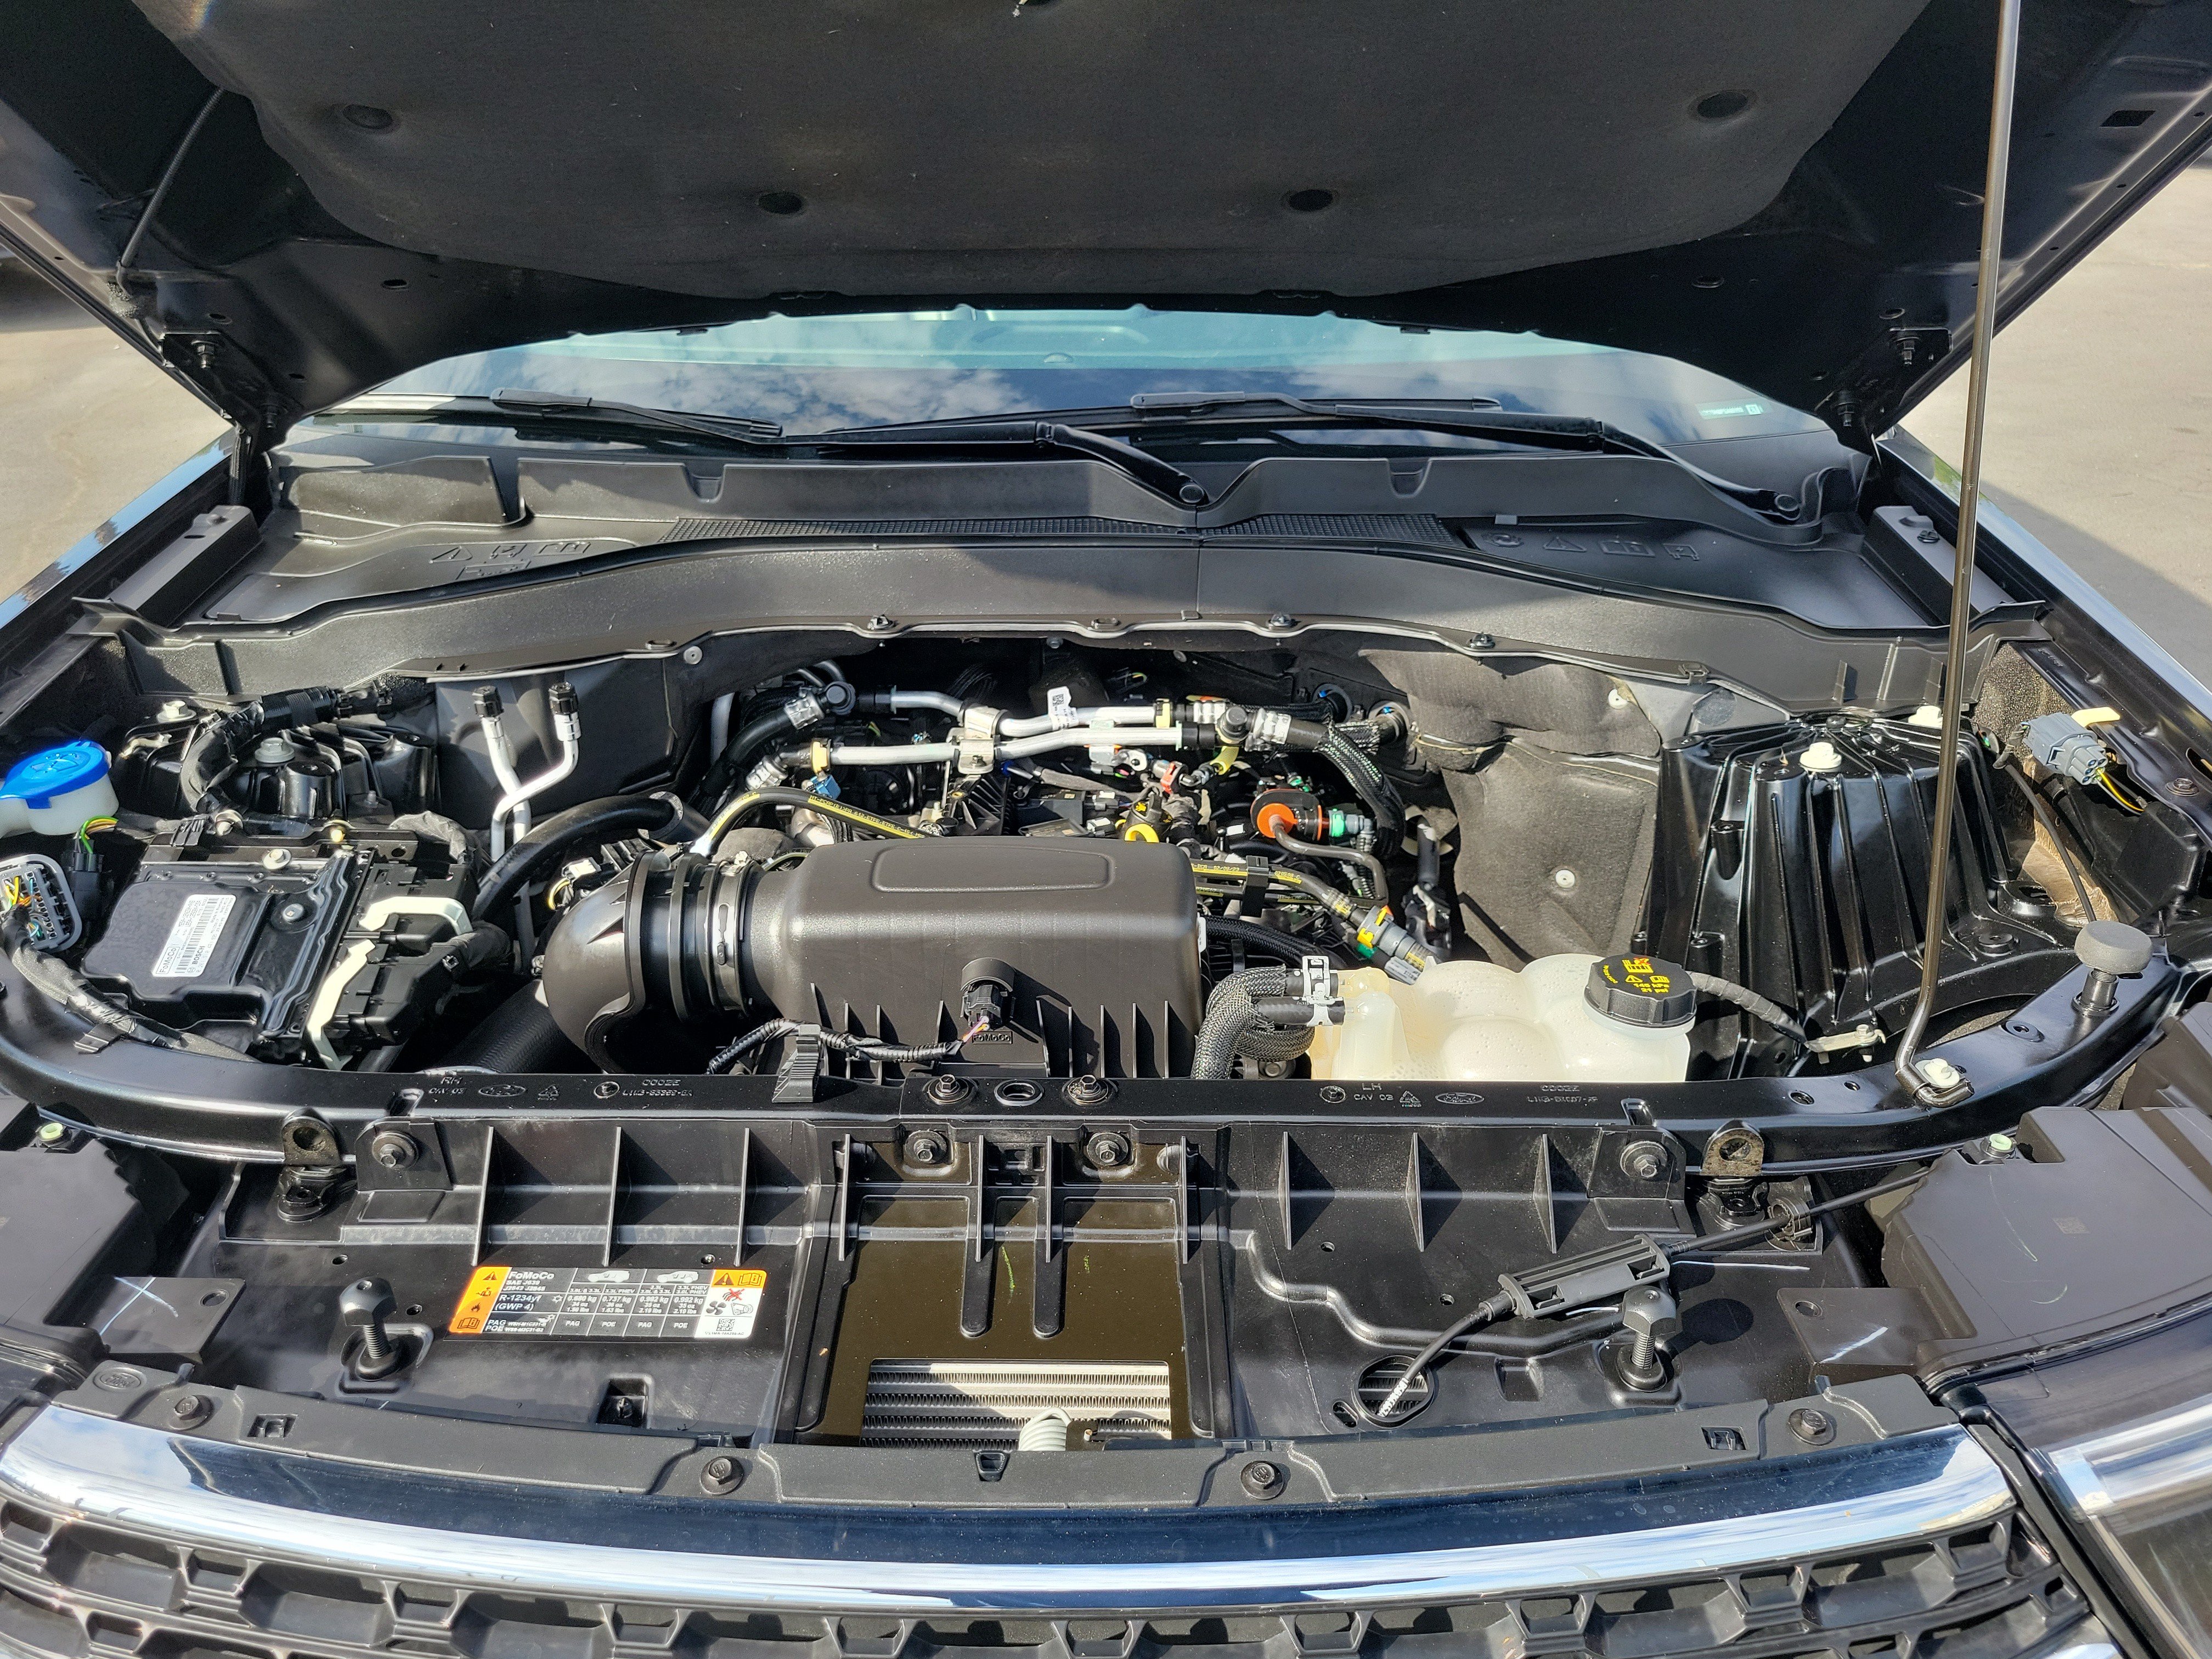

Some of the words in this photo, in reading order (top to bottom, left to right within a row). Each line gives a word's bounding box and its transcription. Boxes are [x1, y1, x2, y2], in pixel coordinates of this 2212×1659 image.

[192, 945, 206, 964] BOSCH
[159, 947, 177, 973] FoMoCo
[973, 1033, 1011, 1041] FoMoCo
[499, 1294, 543, 1302] R-1234yf
[622, 1296, 632, 1304] kg
[495, 1303, 523, 1311] (GWP
[524, 1303, 534, 1311] 4)
